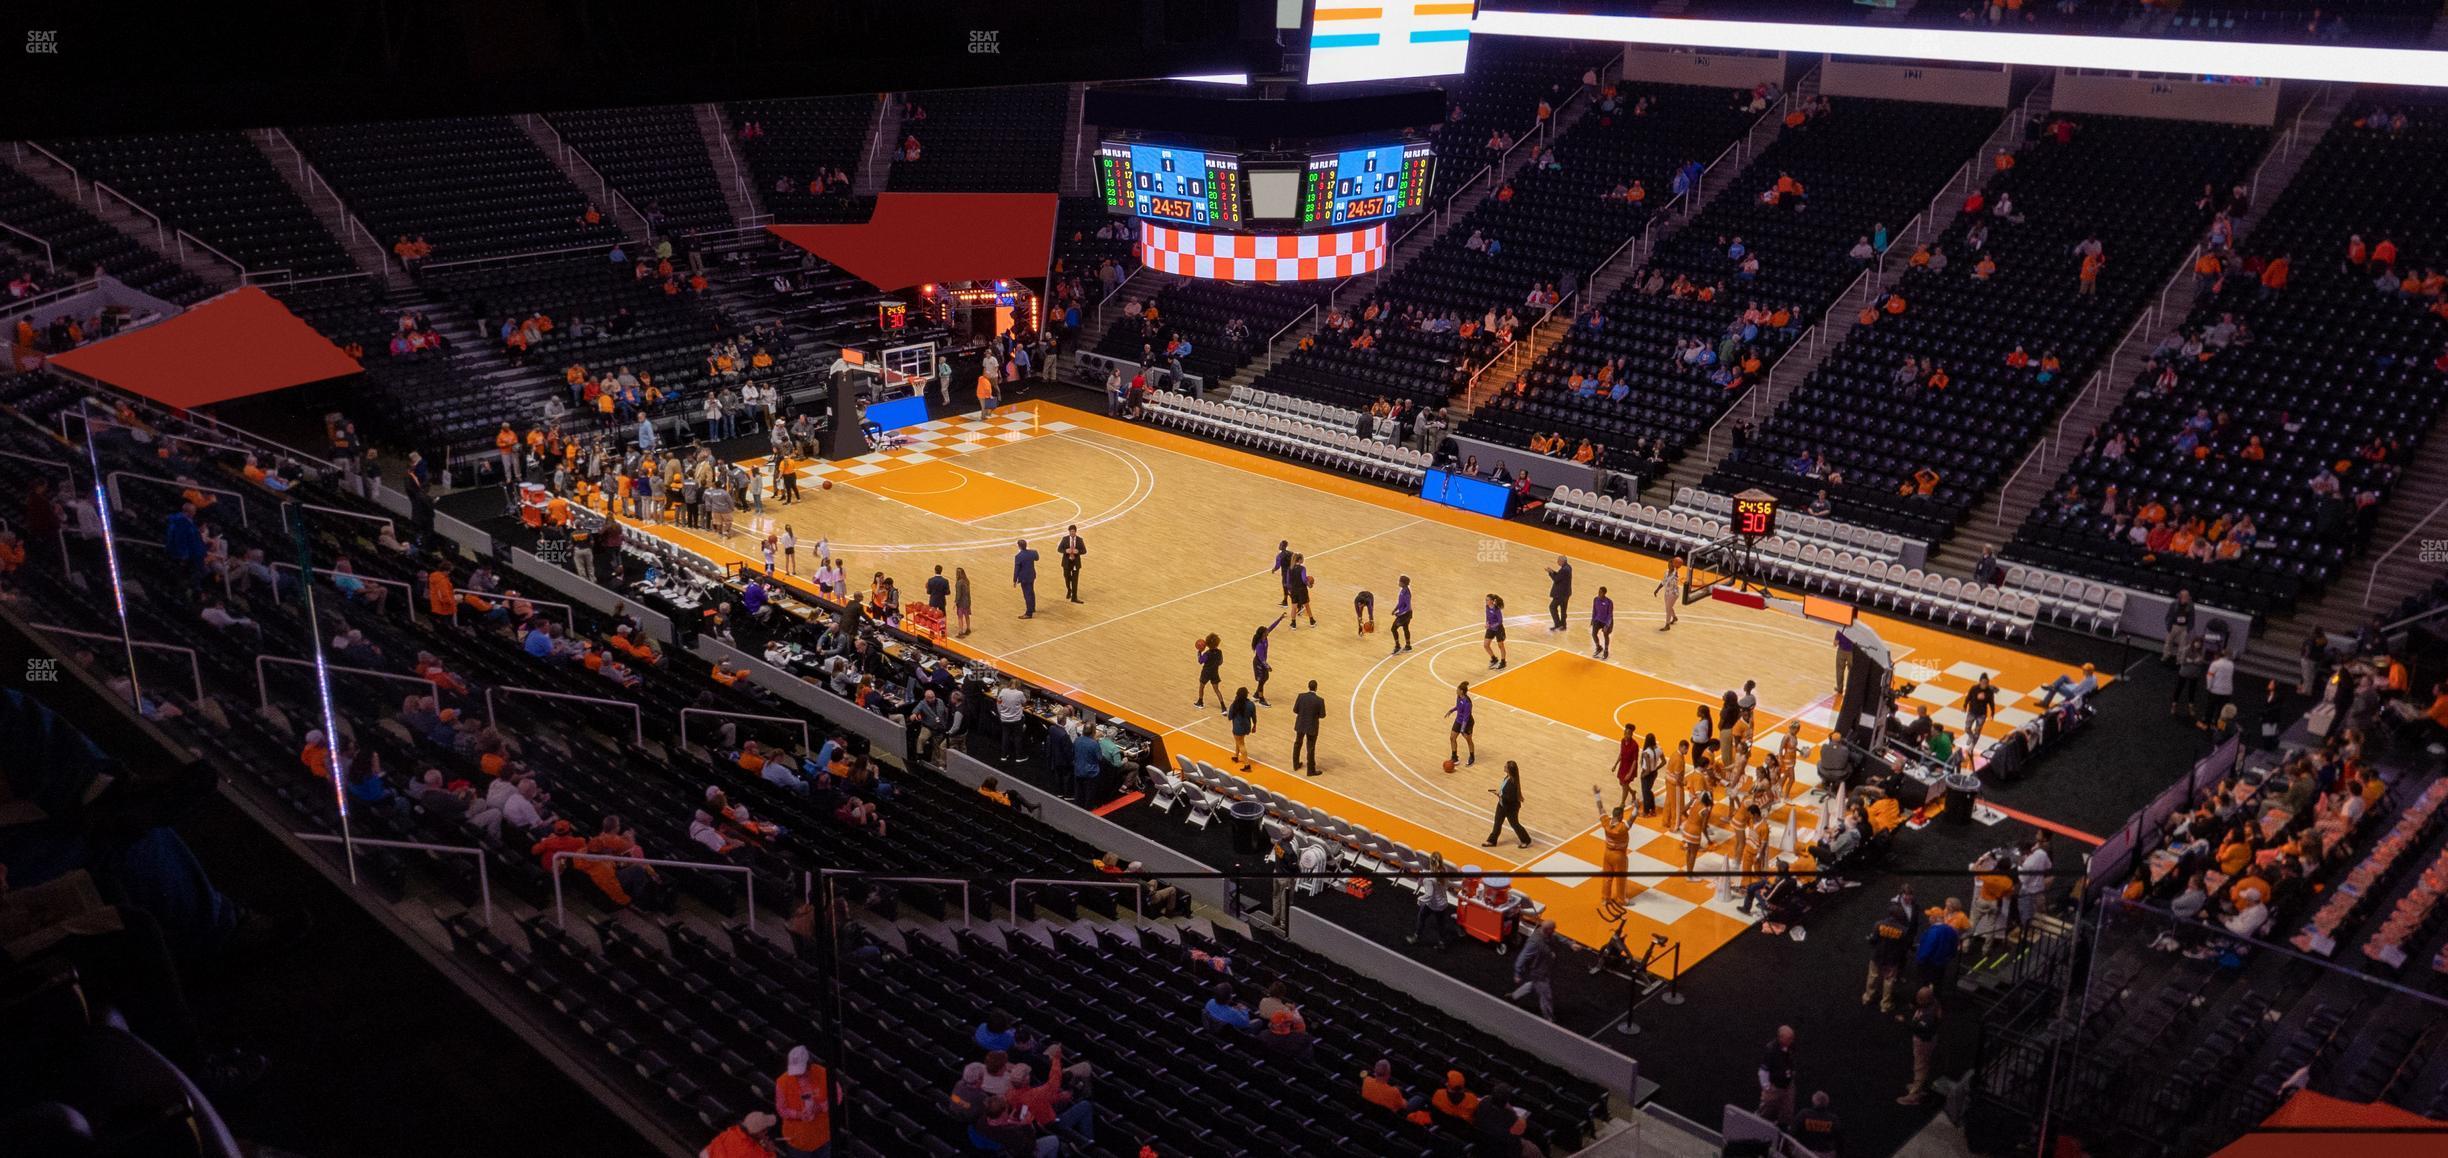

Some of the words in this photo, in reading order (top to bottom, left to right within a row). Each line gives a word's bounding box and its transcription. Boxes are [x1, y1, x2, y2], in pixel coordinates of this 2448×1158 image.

[1141, 176, 1147, 188] 0
[1157, 183, 1162, 191] 4
[1375, 183, 1380, 191] 4
[1388, 175, 1394, 188] 0
[1178, 186, 1184, 194] 4
[1193, 182, 1199, 194] 0
[1342, 182, 1348, 194] 0
[1356, 186, 1360, 194] 4
[1142, 205, 1147, 213] 0
[1152, 198, 1191, 217] 24:57
[1348, 197, 1384, 218] 24:57
[1387, 205, 1392, 213] 0
[1337, 212, 1342, 220] 0
[888, 306, 905, 315] 24:56
[891, 315, 904, 328] 30
[1739, 501, 1771, 514] 24:56
[1743, 514, 1765, 532] 30
